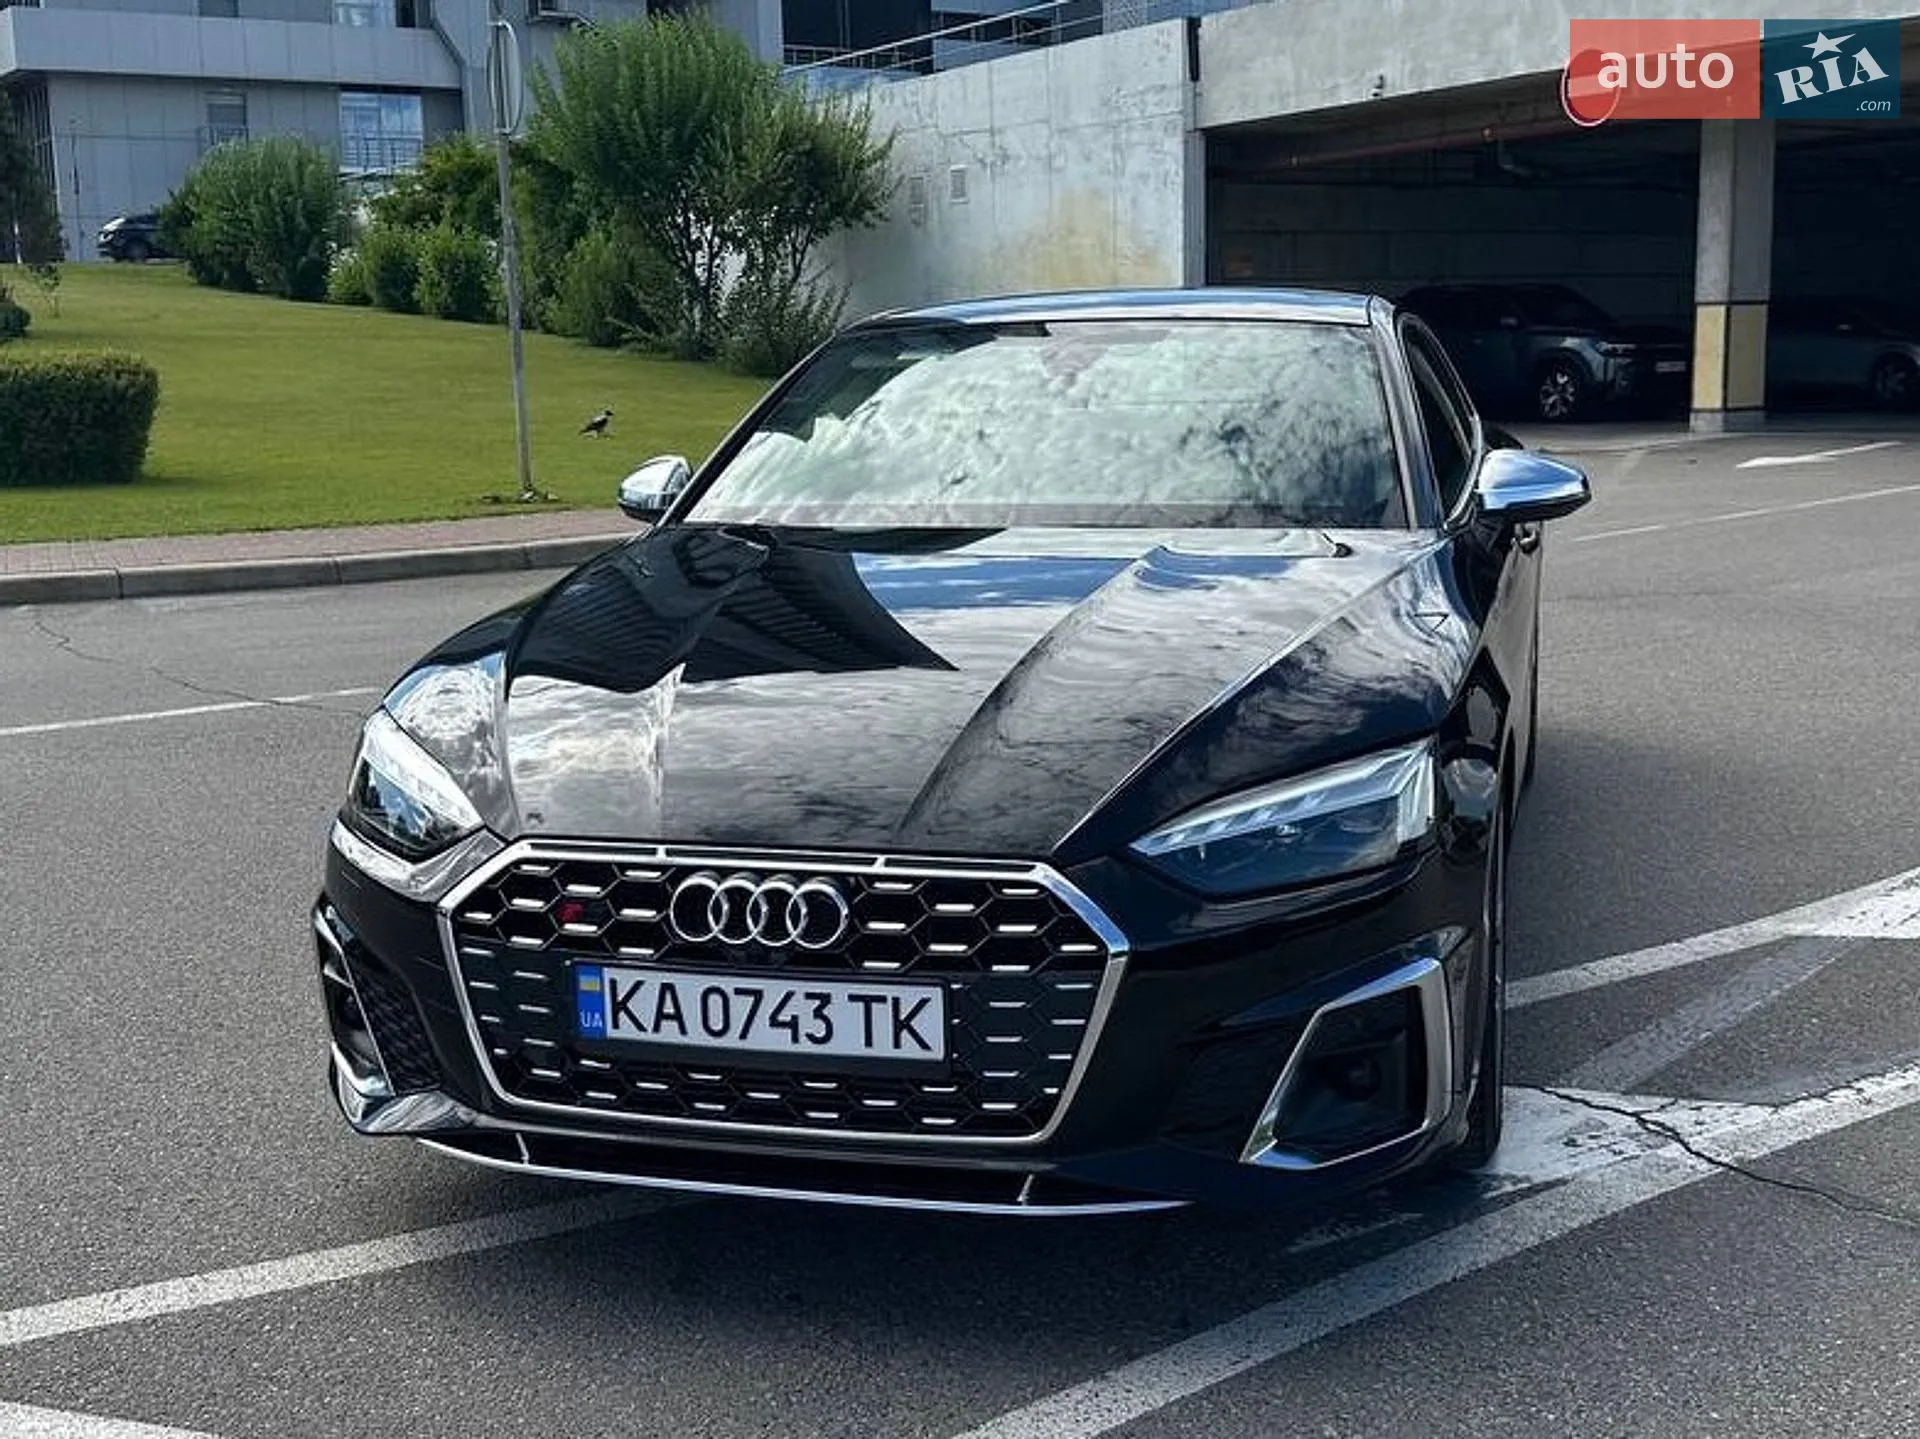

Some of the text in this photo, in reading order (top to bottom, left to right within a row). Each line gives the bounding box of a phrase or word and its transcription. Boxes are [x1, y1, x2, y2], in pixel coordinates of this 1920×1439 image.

[580, 1010, 603, 1028] UA
[608, 978, 933, 1051] KA 0743 TK
